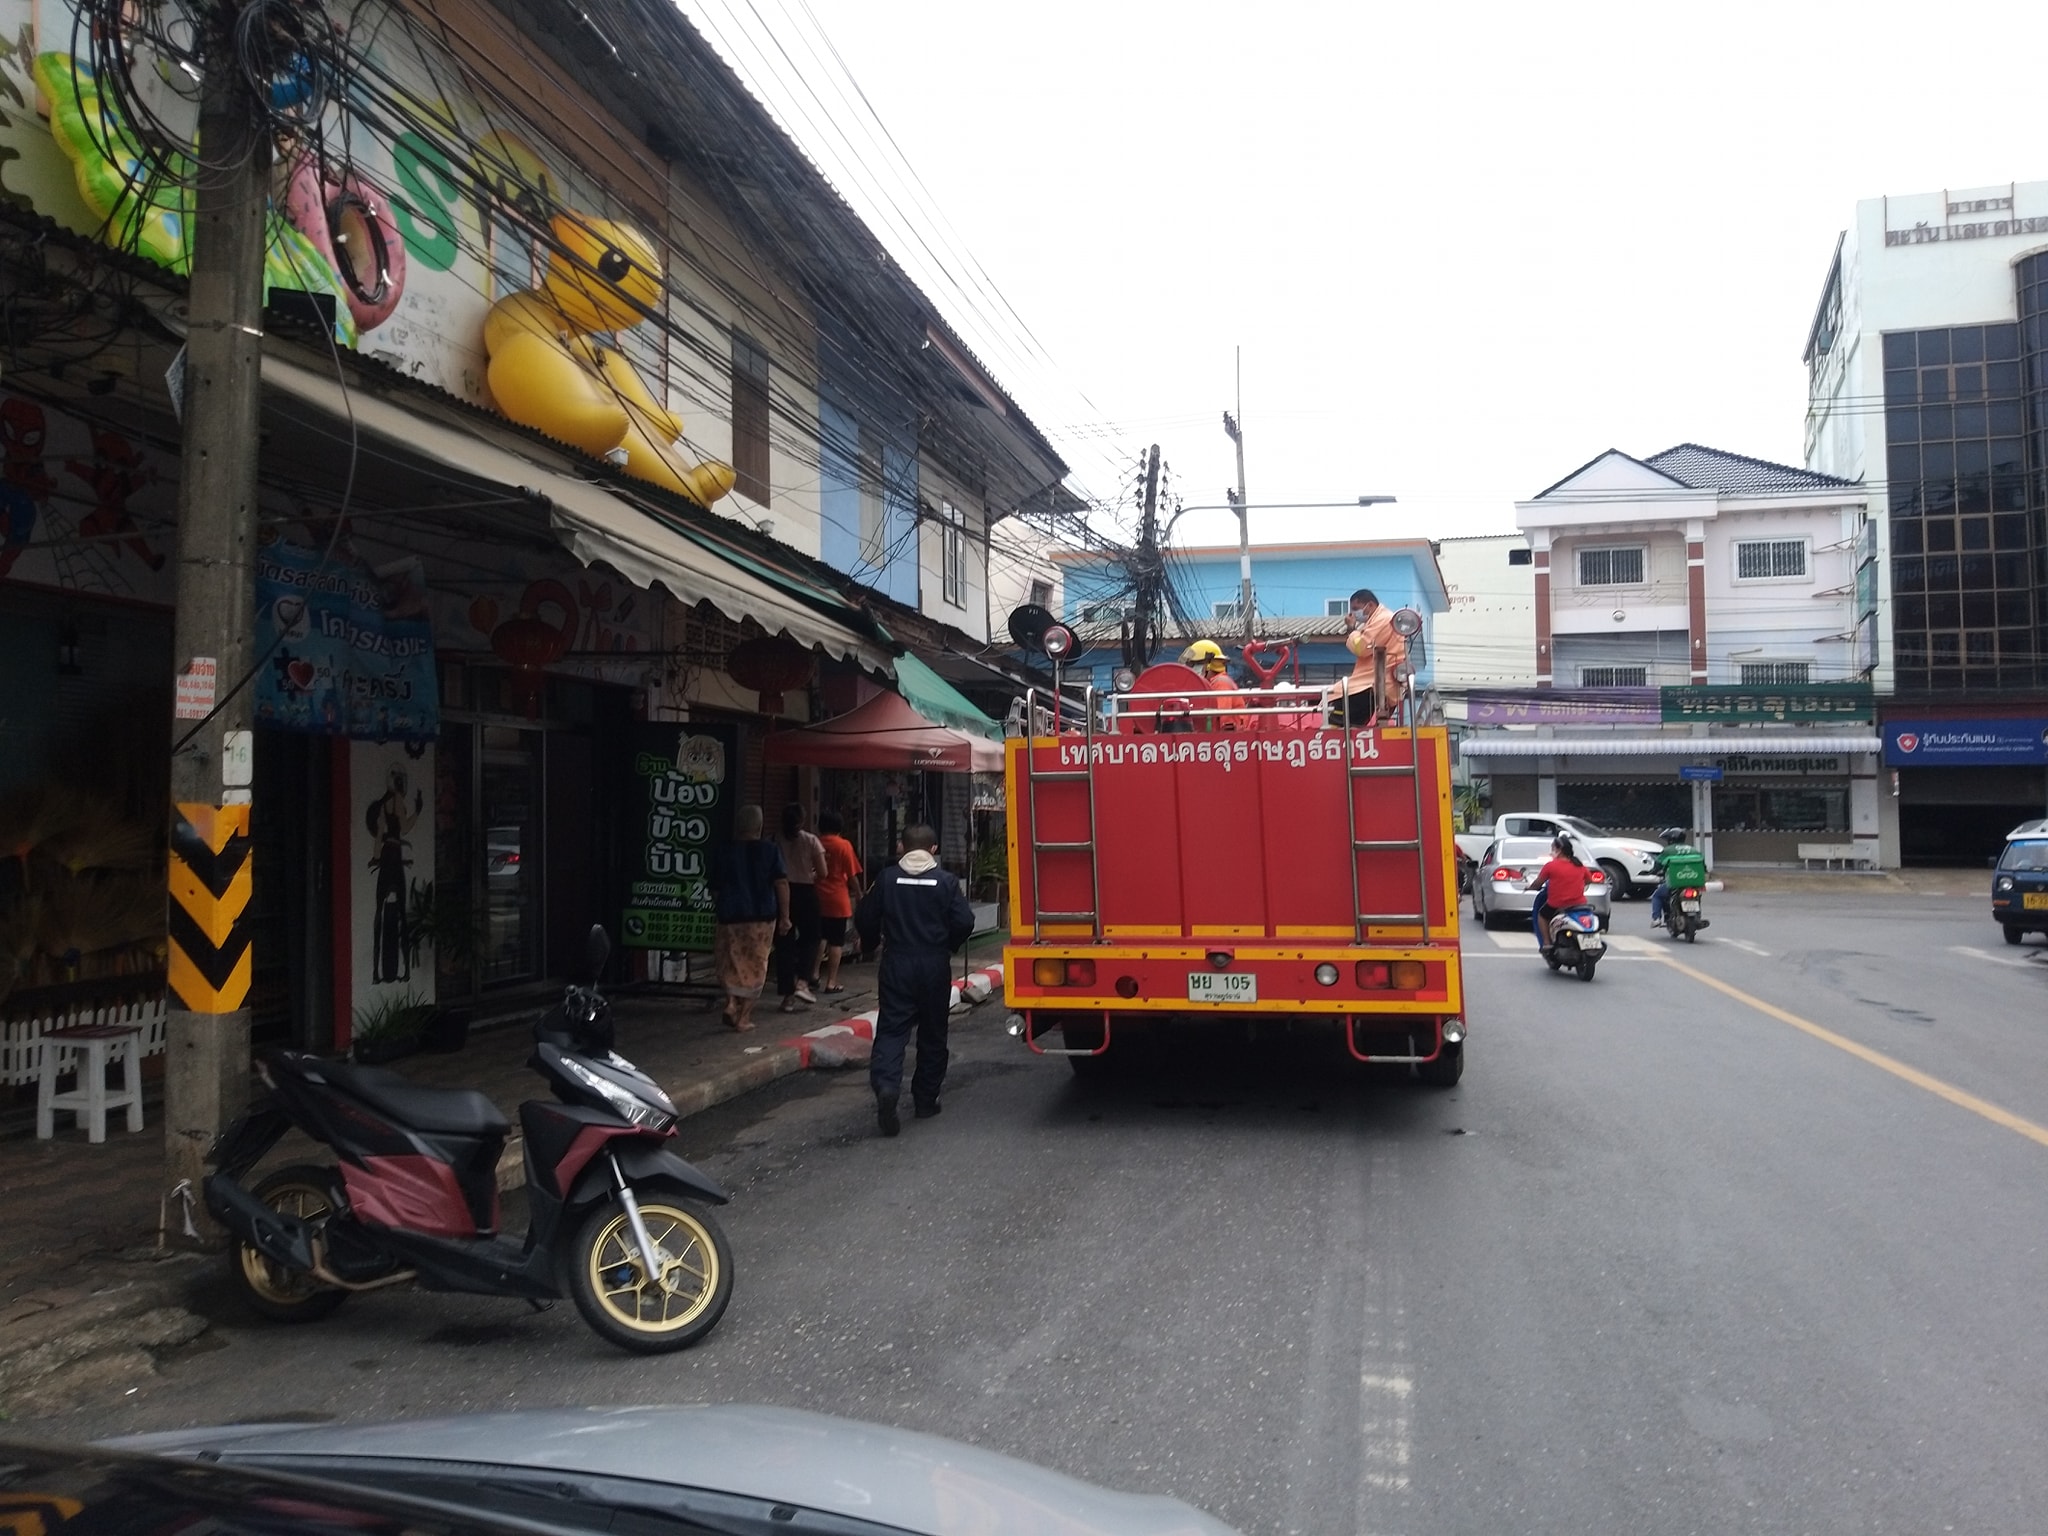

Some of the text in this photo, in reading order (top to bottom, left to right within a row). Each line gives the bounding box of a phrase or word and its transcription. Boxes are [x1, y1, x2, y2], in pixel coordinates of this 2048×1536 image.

[342, 665, 412, 700] คะครึ่ง
[1061, 731, 1379, 772] เทศบาลนครสุราษฎร์ธานี
[653, 770, 715, 806] น้อง
[651, 806, 707, 840] ข้าว
[1676, 871, 1699, 880] Grab
[1224, 975, 1250, 990] 105
